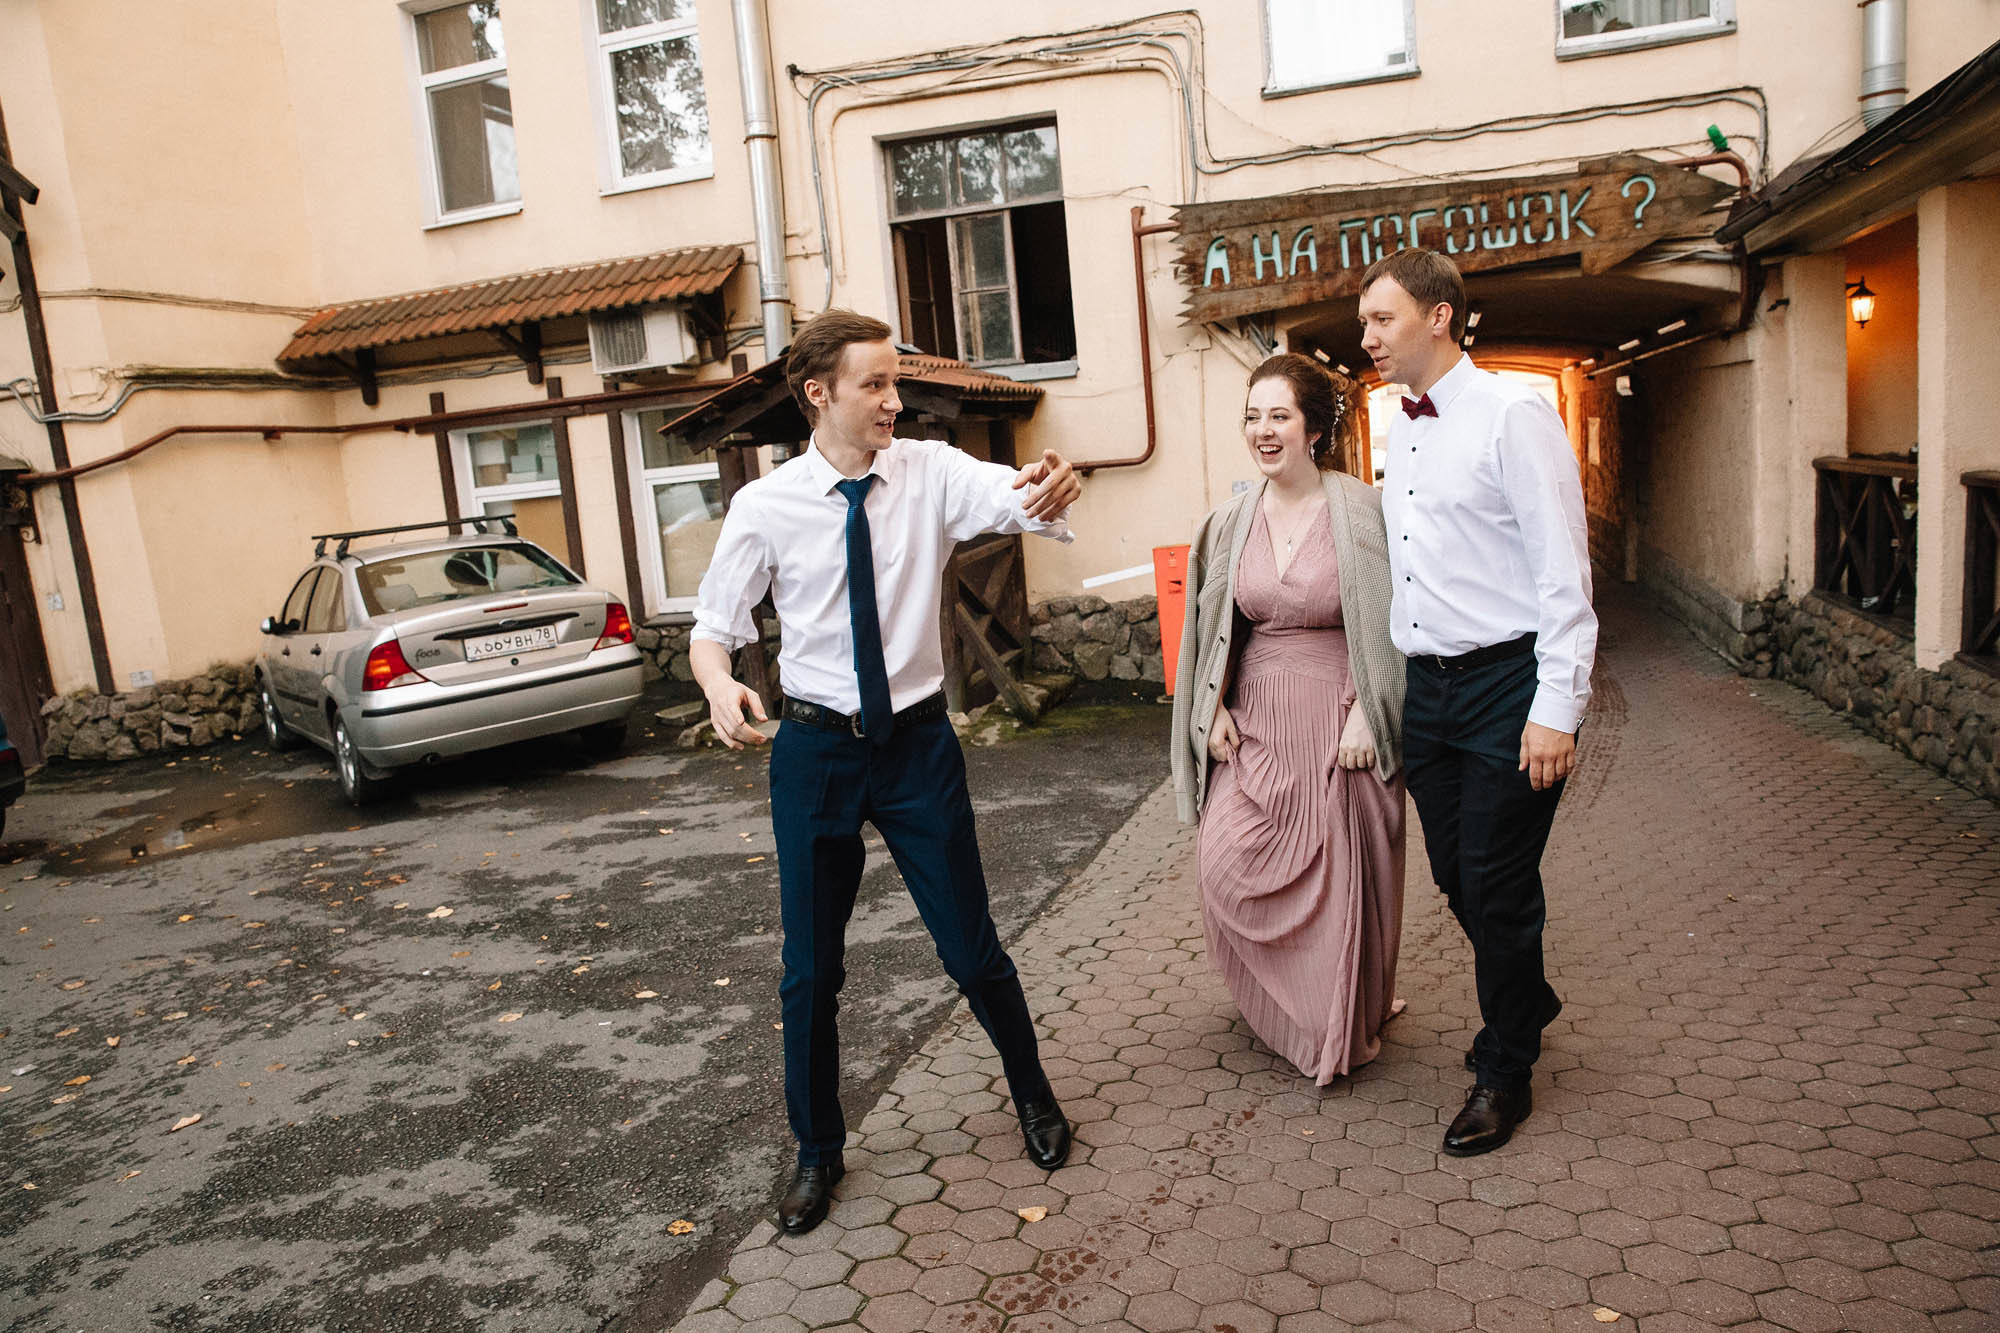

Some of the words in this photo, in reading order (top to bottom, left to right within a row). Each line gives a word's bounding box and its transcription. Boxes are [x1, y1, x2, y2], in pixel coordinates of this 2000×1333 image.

[1202, 235, 1231, 288] А
[1251, 225, 1318, 281] НА
[1620, 174, 1657, 230] ?
[535, 628, 551, 641] 78
